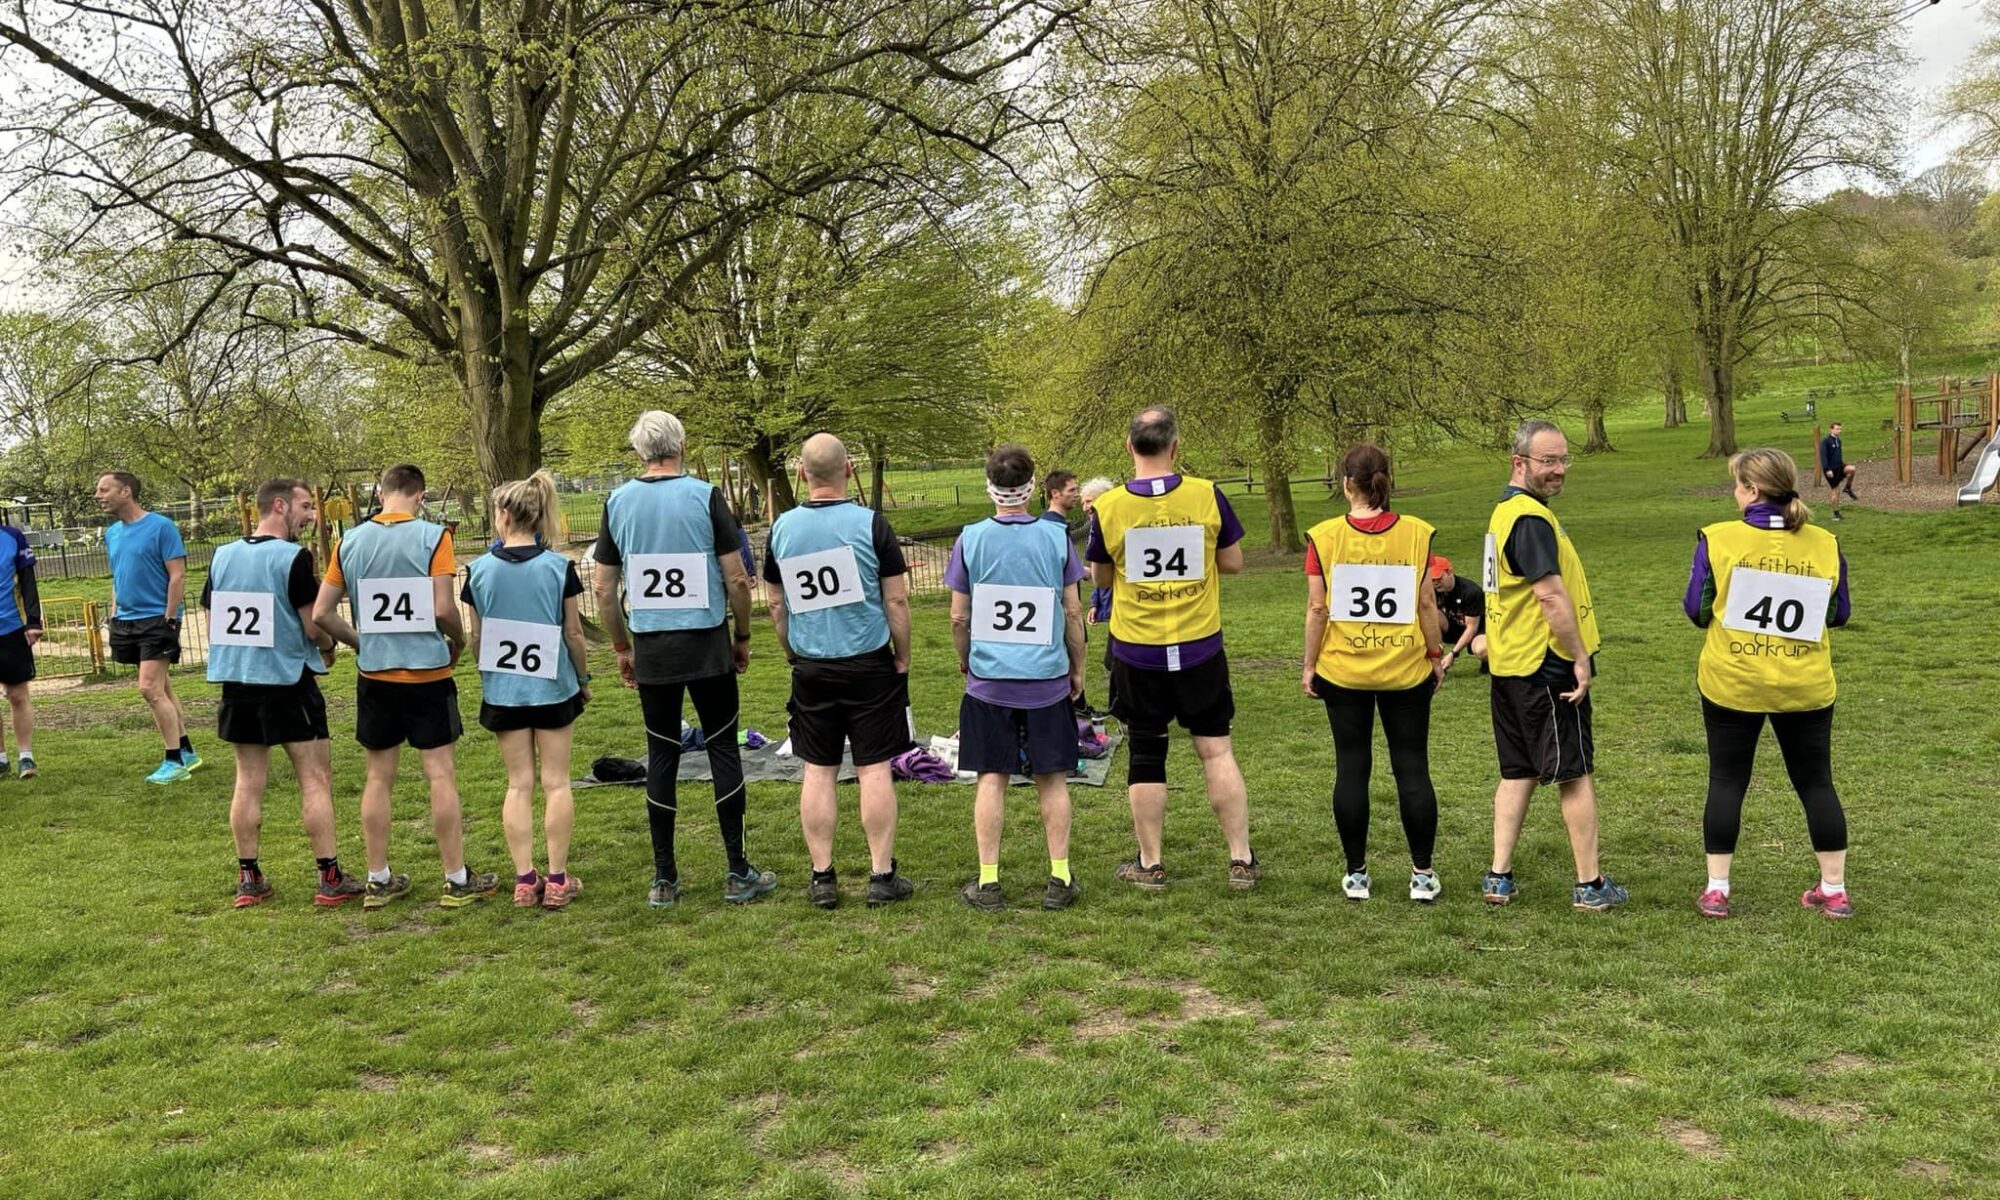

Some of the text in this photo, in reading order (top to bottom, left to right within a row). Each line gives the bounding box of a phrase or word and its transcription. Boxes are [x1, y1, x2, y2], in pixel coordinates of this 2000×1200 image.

[1144, 548, 1187, 577] 34
[643, 569, 685, 597] 28
[797, 566, 839, 600] 30
[373, 593, 413, 621] 24
[993, 601, 1036, 632] 32
[1350, 587, 1396, 618] 36
[1745, 597, 1804, 632] 40
[227, 607, 260, 635] 22
[496, 640, 541, 672] 26
